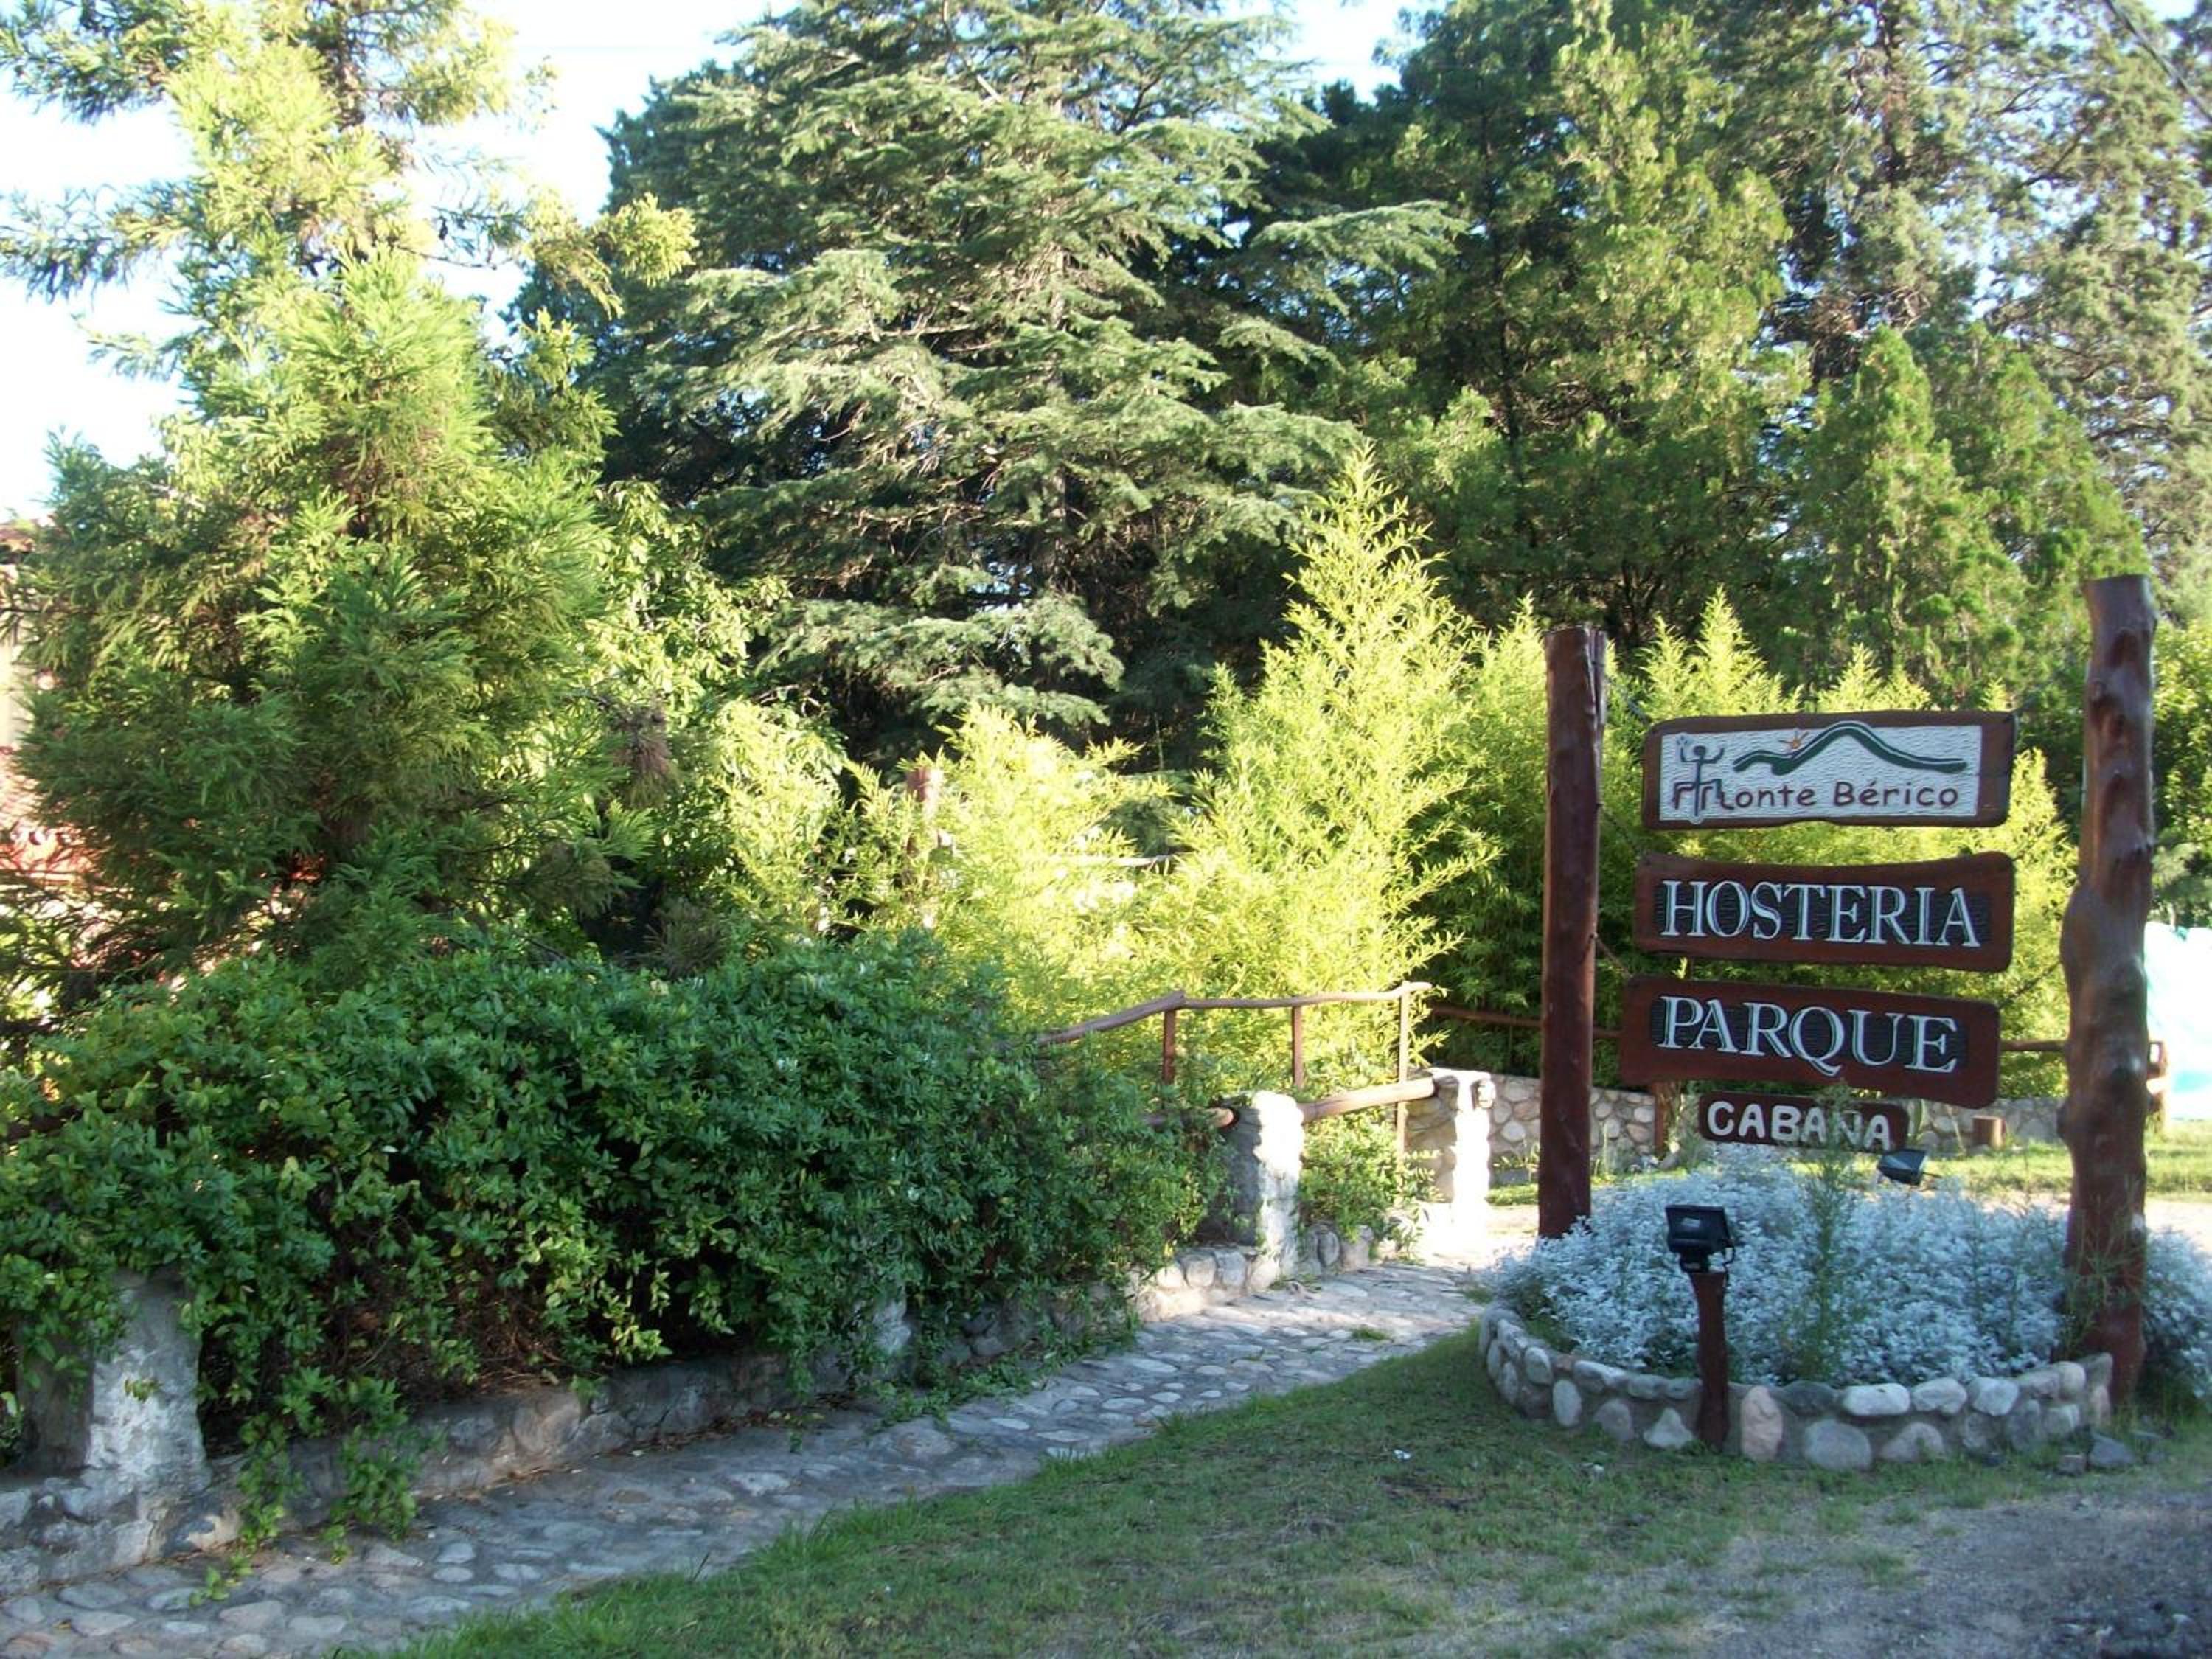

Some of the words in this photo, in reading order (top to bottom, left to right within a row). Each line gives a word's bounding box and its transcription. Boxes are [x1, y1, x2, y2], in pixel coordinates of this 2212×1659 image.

[1672, 778, 1817, 815] Monte
[1833, 780, 1959, 807] Bérico
[1660, 880, 1981, 948] HOSTERIA
[1657, 995, 1958, 1077] PARQUE
